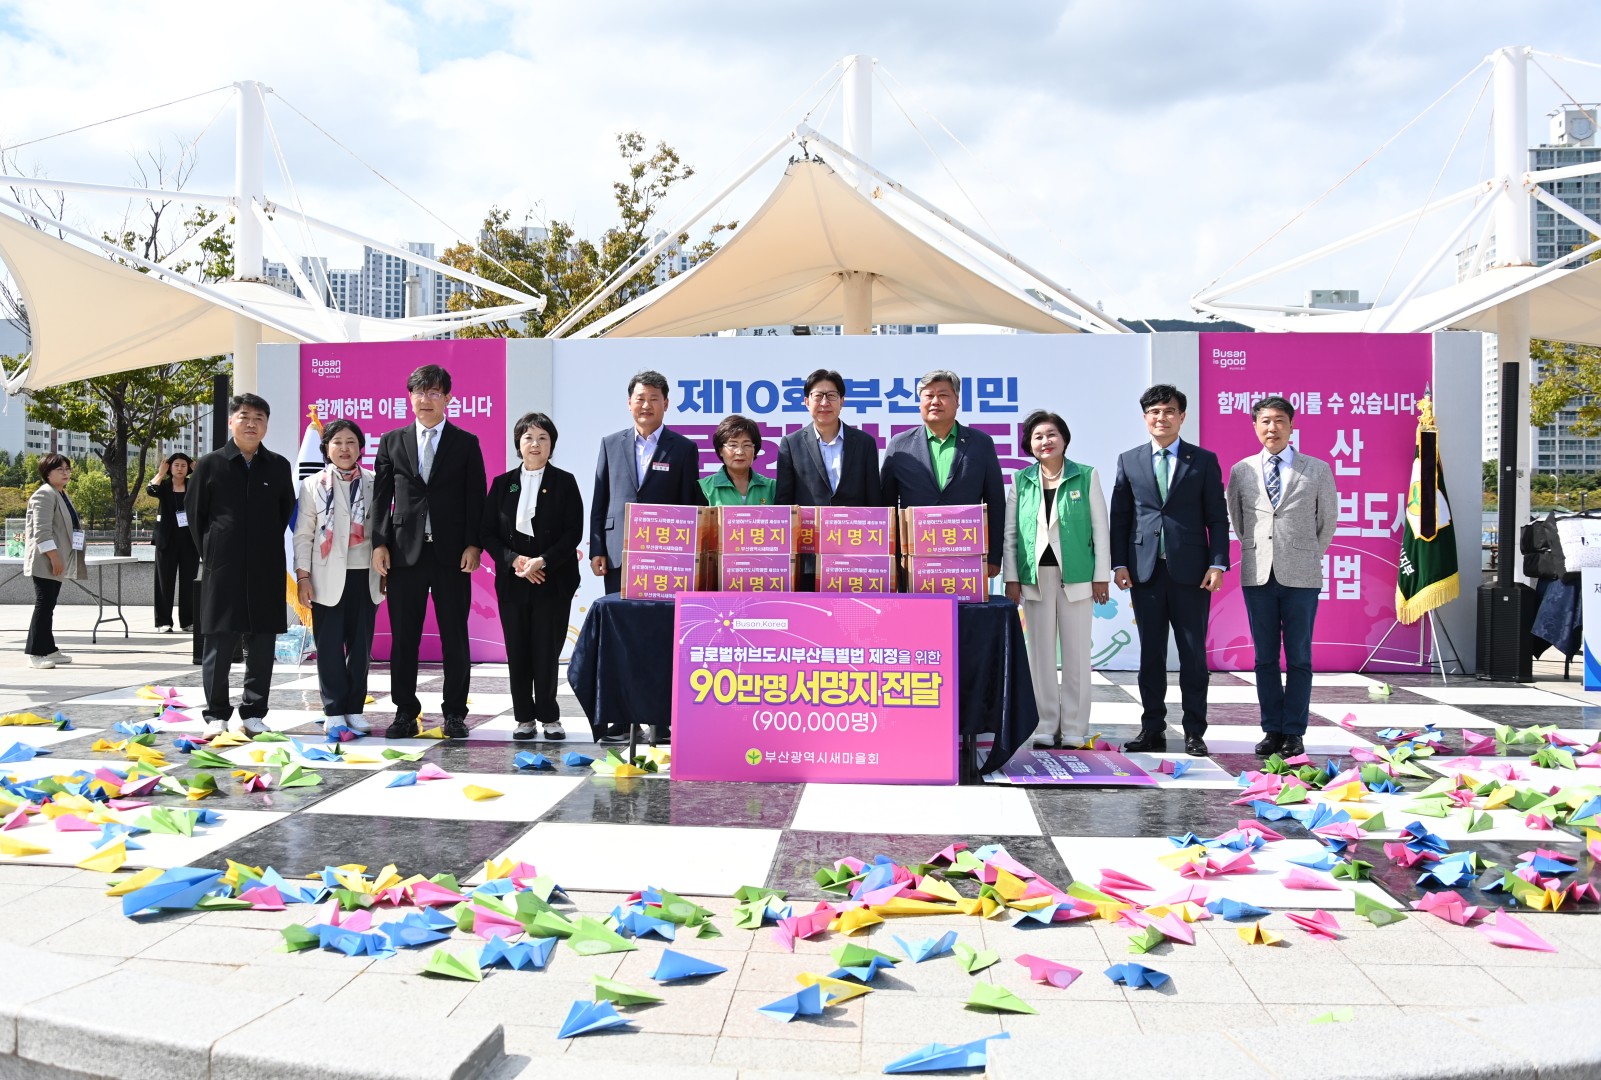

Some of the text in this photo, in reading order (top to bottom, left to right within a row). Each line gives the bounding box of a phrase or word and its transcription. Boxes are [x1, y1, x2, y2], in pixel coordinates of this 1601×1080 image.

[1213, 349, 1246, 357] Busan
[318, 367, 341, 376] good
[1220, 358, 1246, 368] good
[843, 377, 1018, 414] 부산민
[1290, 392, 1322, 415] 이룰
[1327, 392, 1344, 415] 수
[1350, 392, 1416, 415] 있습니다
[316, 396, 492, 419] 함께하면 이룰 습니다
[735, 620, 787, 628] Busan.Korea
[690, 646, 941, 665] 글로벌허브도시부산특별법 제정을 위한
[689, 668, 943, 706] 90만명 서명지 전달
[752, 710, 878, 733] (900,000명)
[765, 751, 879, 765] 부산광역시새마을회
